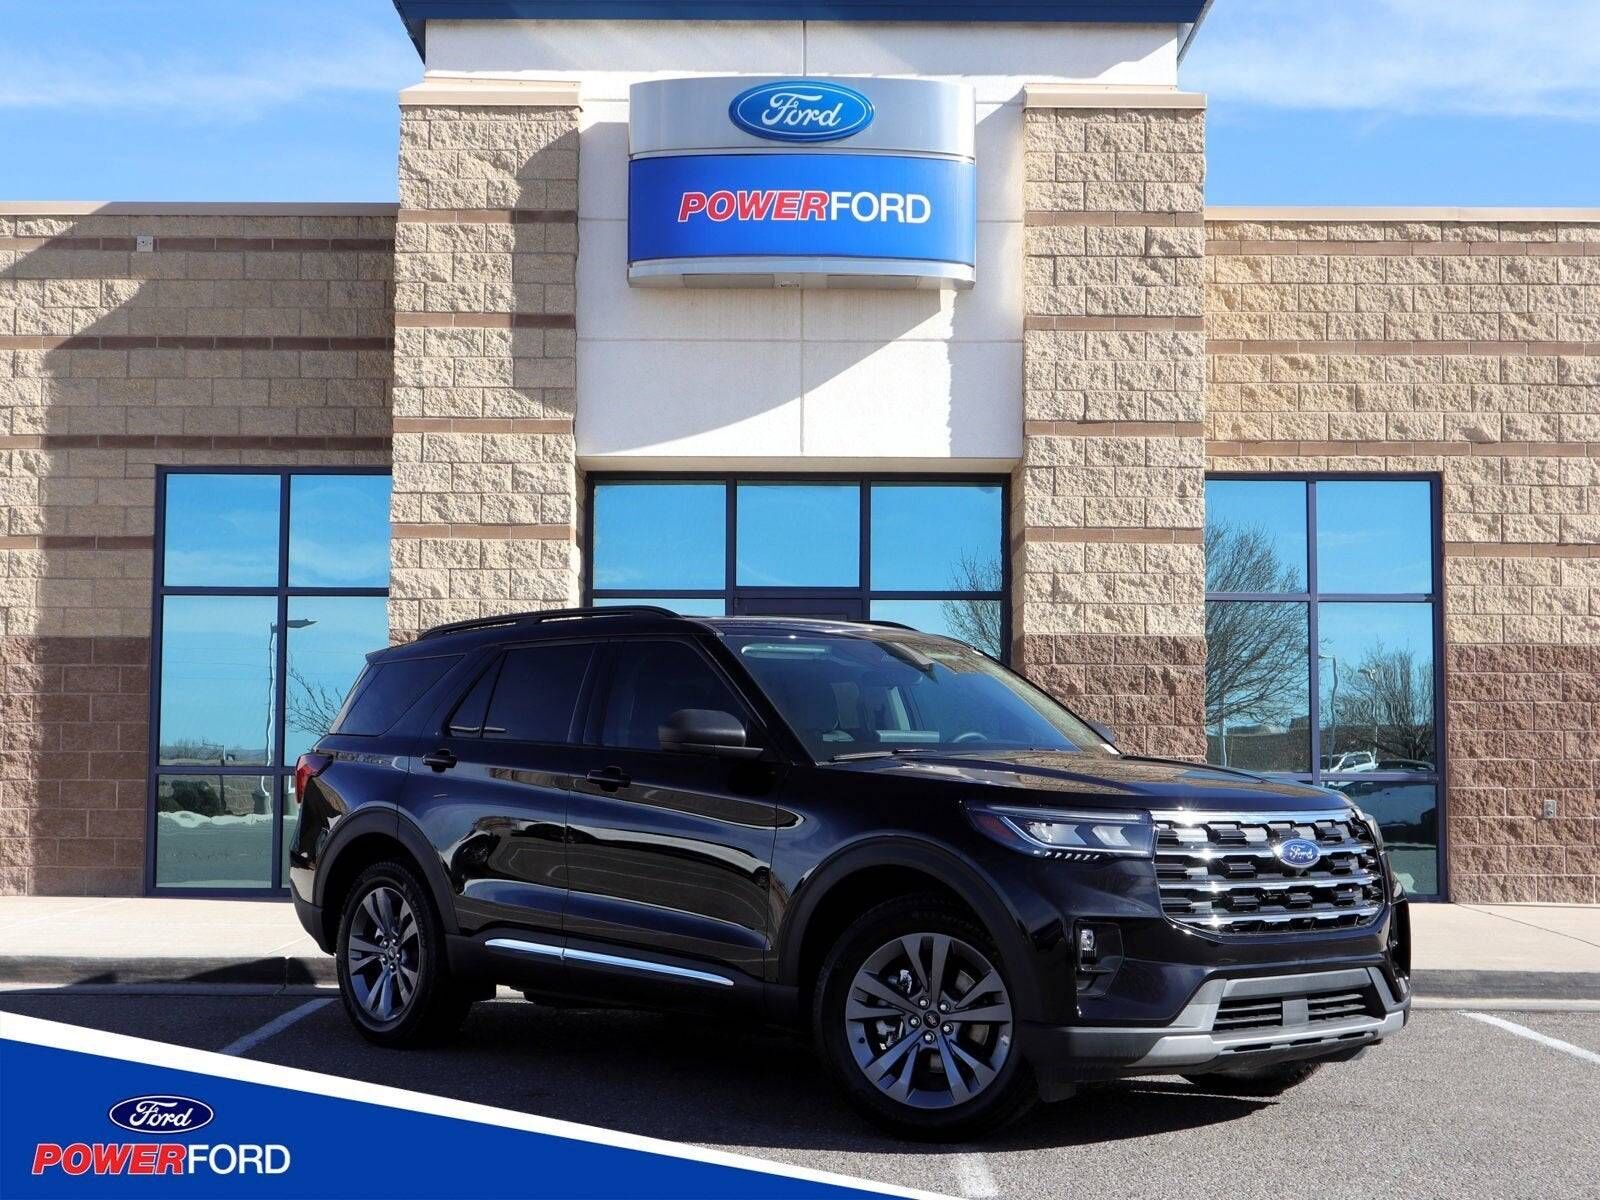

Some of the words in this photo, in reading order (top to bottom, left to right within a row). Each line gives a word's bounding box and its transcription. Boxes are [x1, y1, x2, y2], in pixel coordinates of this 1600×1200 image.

[761, 92, 843, 127] Ford
[677, 190, 931, 224] POWERFORD
[1289, 844, 1314, 860] Ford
